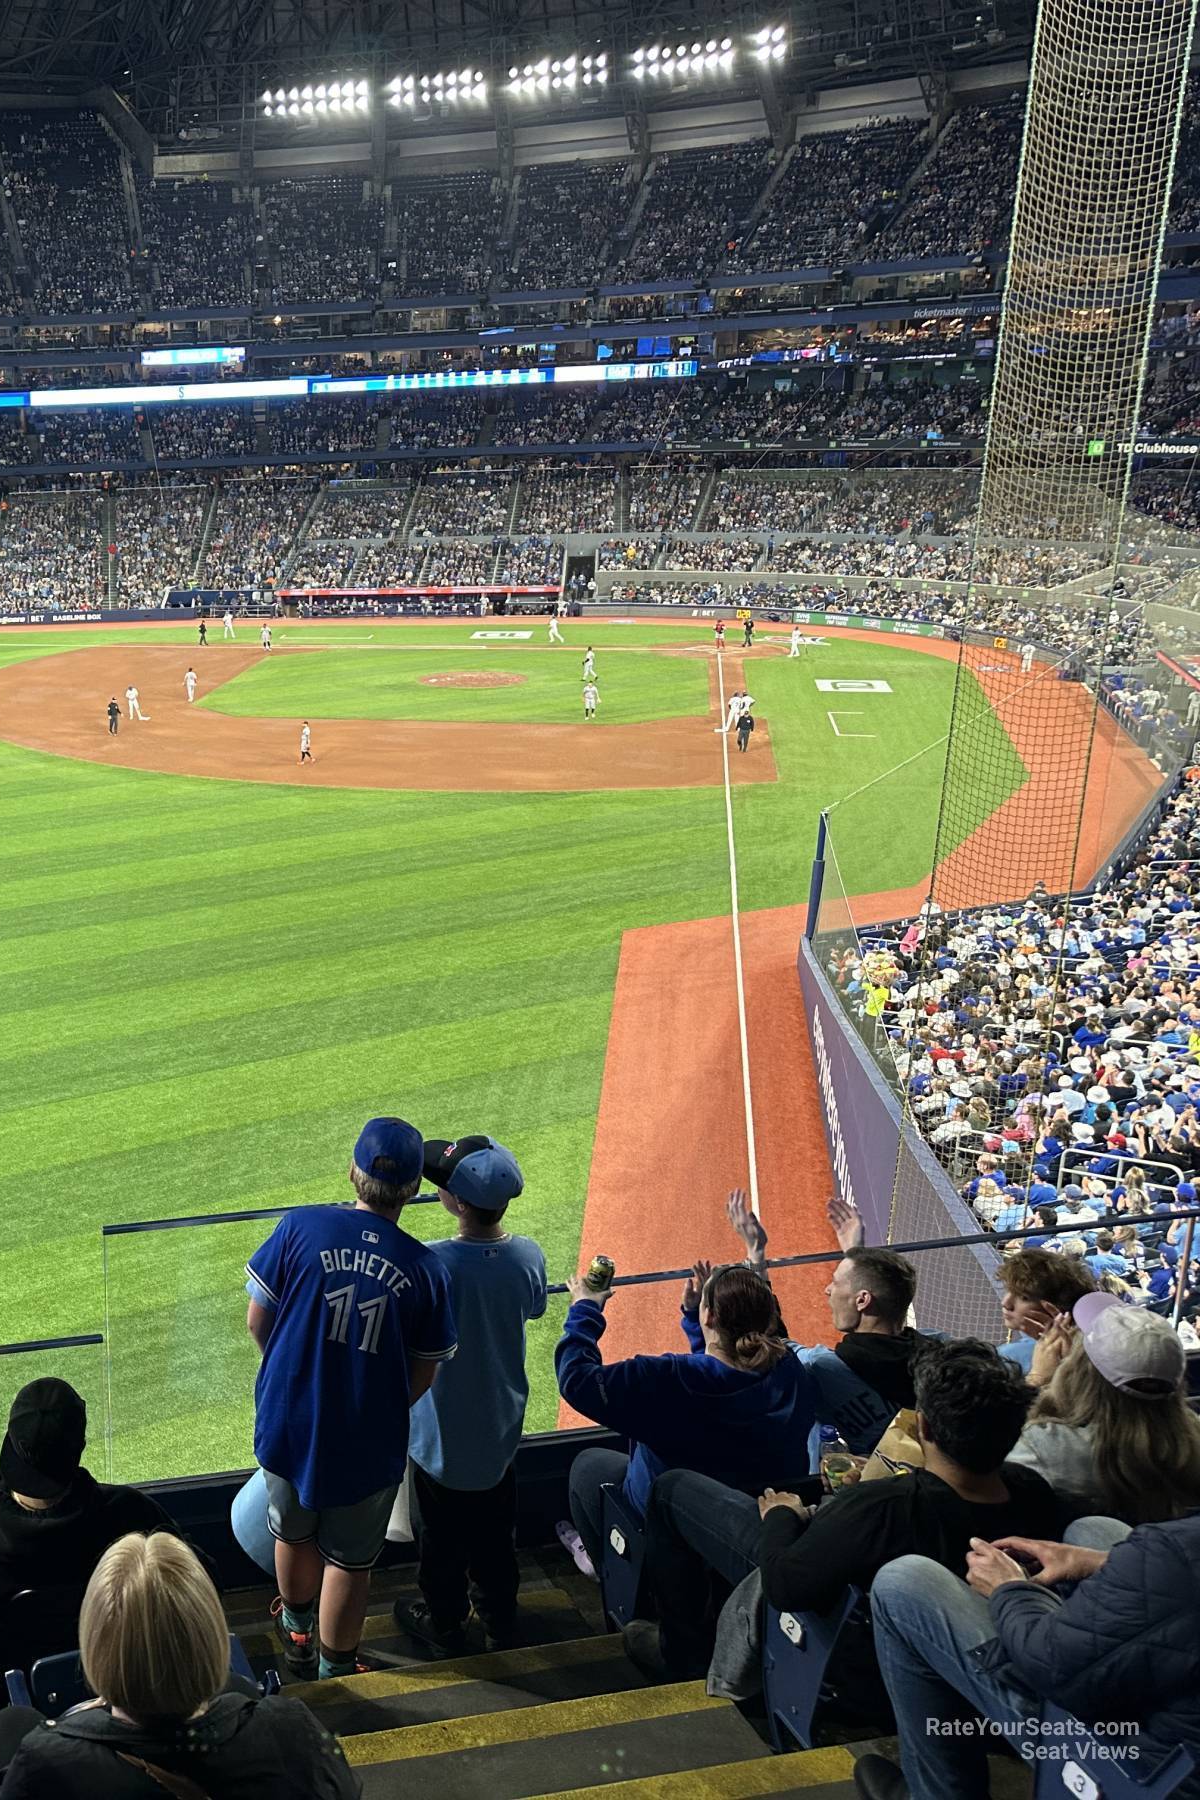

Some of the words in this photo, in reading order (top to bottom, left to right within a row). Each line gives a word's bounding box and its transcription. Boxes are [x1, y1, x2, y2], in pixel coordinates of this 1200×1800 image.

[914, 307, 968, 318] ticketmaster
[977, 305, 1000, 313] LOUNG
[1134, 442, 1198, 454] Clubhouse
[320, 1248, 411, 1298] BICHETTE
[323, 1283, 388, 1354] 11
[785, 1619, 795, 1635] 2
[1073, 1775, 1085, 1792] 3
